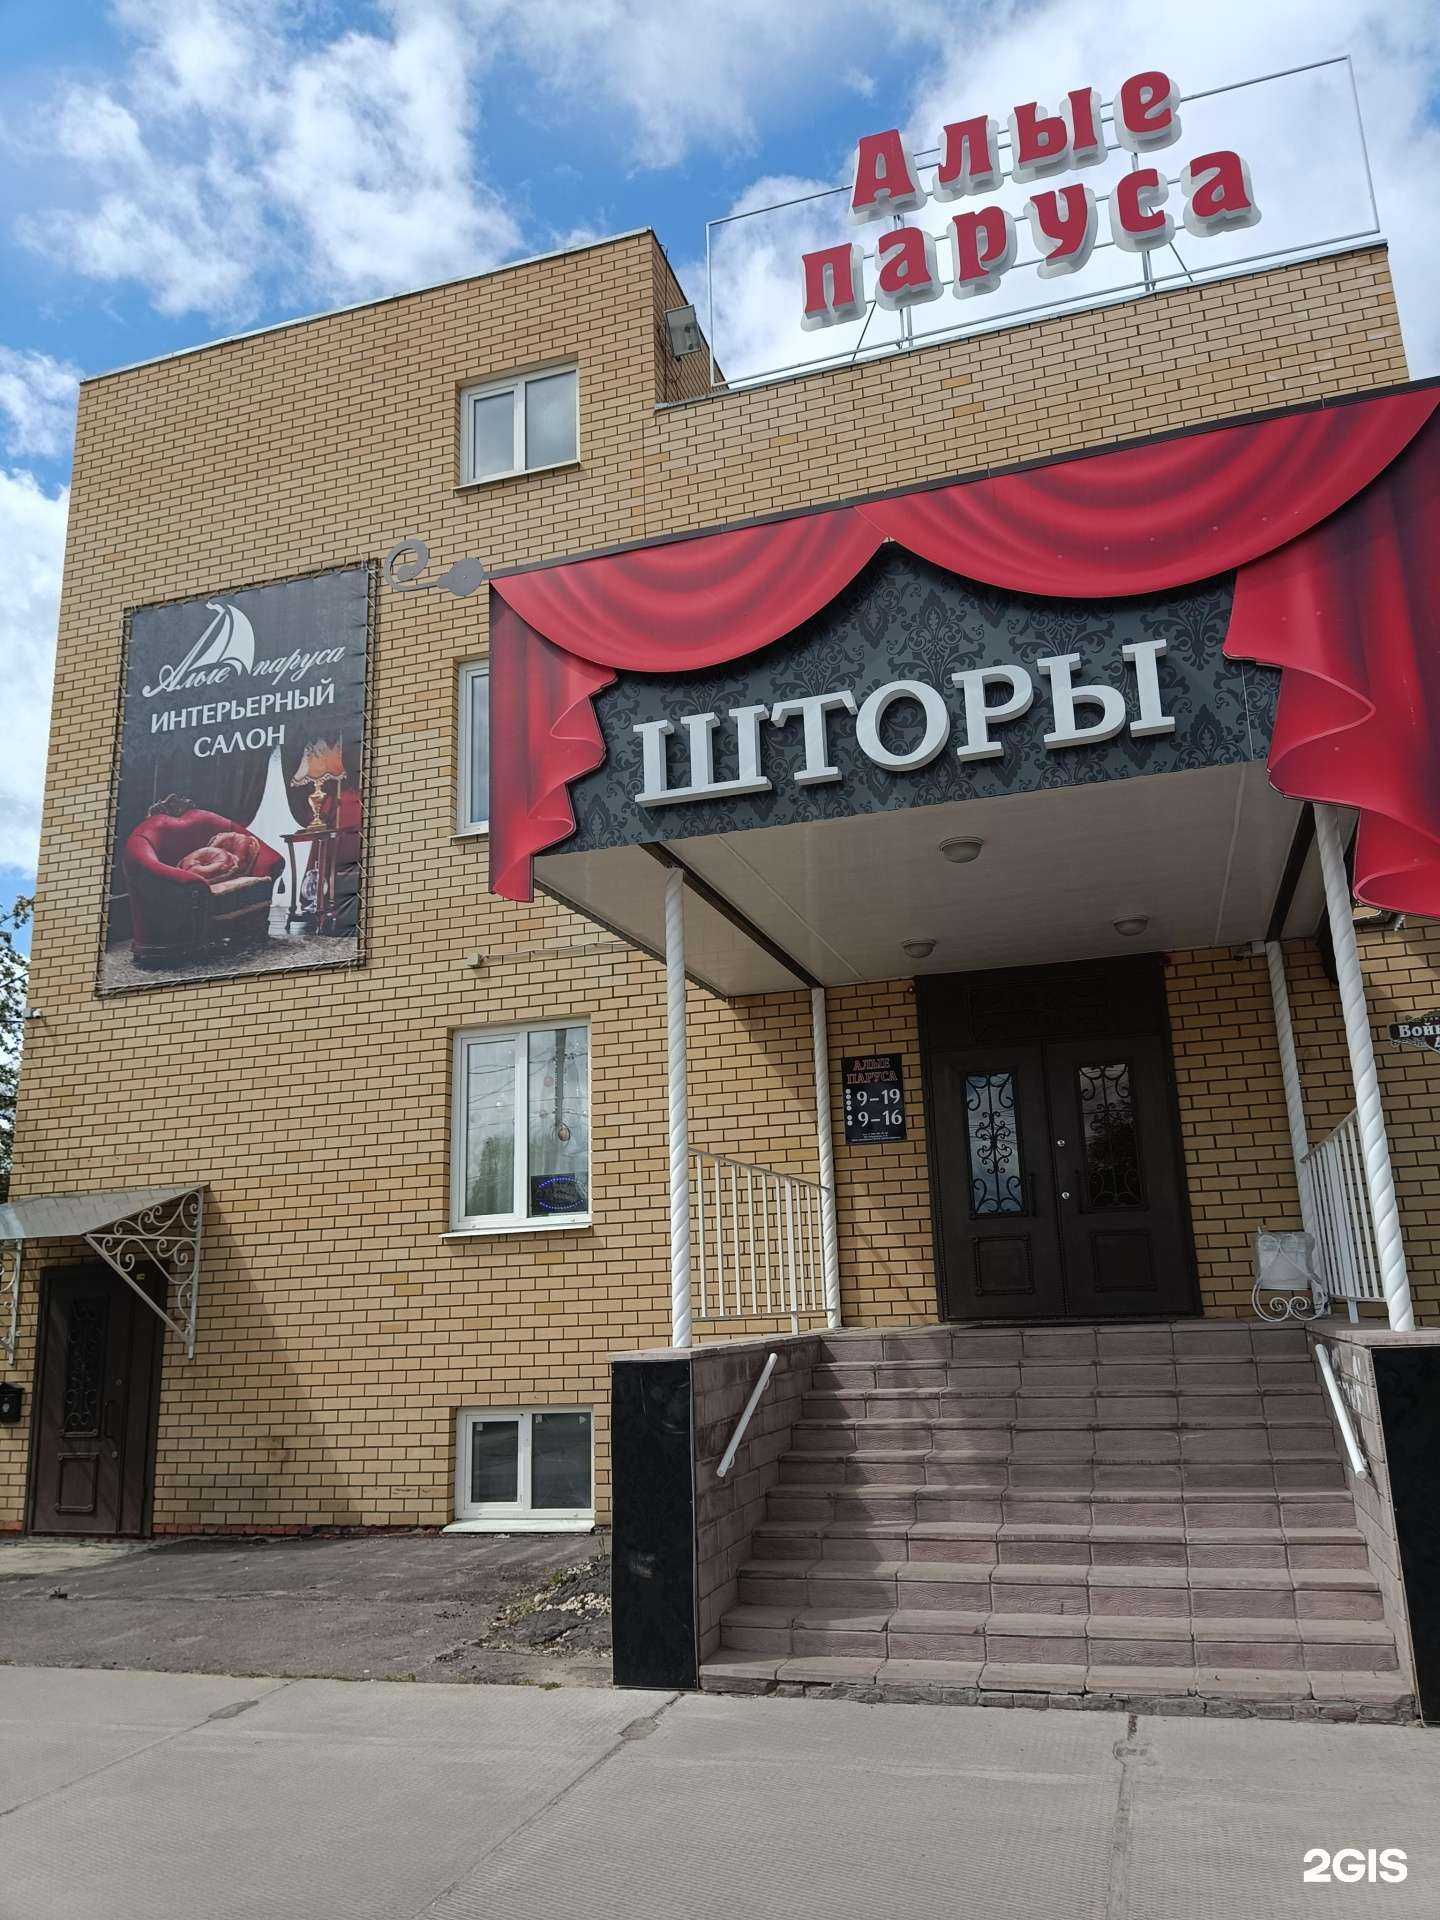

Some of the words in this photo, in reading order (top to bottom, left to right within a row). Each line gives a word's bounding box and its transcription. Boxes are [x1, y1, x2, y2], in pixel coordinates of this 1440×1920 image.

[850, 70, 1181, 222] Алые
[801, 150, 1262, 329] паруса
[253, 646, 346, 686] паруса
[151, 677, 335, 733] ИНТЕРЬЕРНЫЙ
[633, 639, 1176, 807] ШТОРЫ
[194, 724, 285, 757] САЛОН
[1399, 1022, 1440, 1038] Вой
